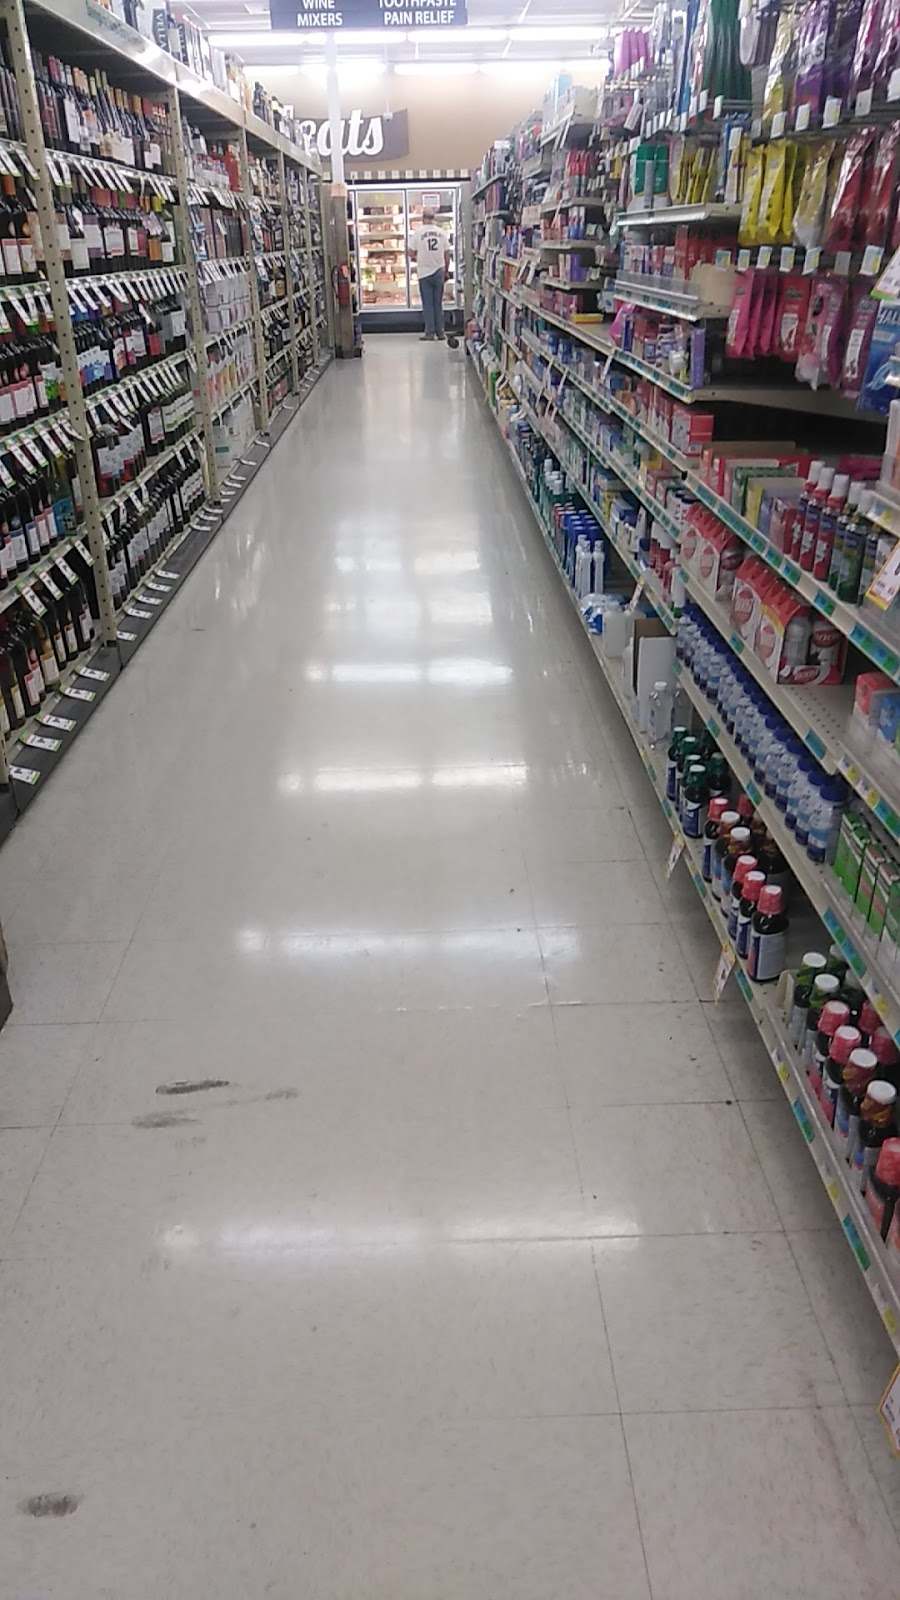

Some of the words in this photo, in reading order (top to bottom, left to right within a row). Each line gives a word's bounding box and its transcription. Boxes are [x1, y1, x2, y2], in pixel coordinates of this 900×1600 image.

[303, 0, 335, 9] WINE
[297, 12, 343, 27] MIXERS
[384, 11, 413, 25] PAIN
[415, 10, 455, 25] RELIEF
[427, 238, 438, 251] 12
